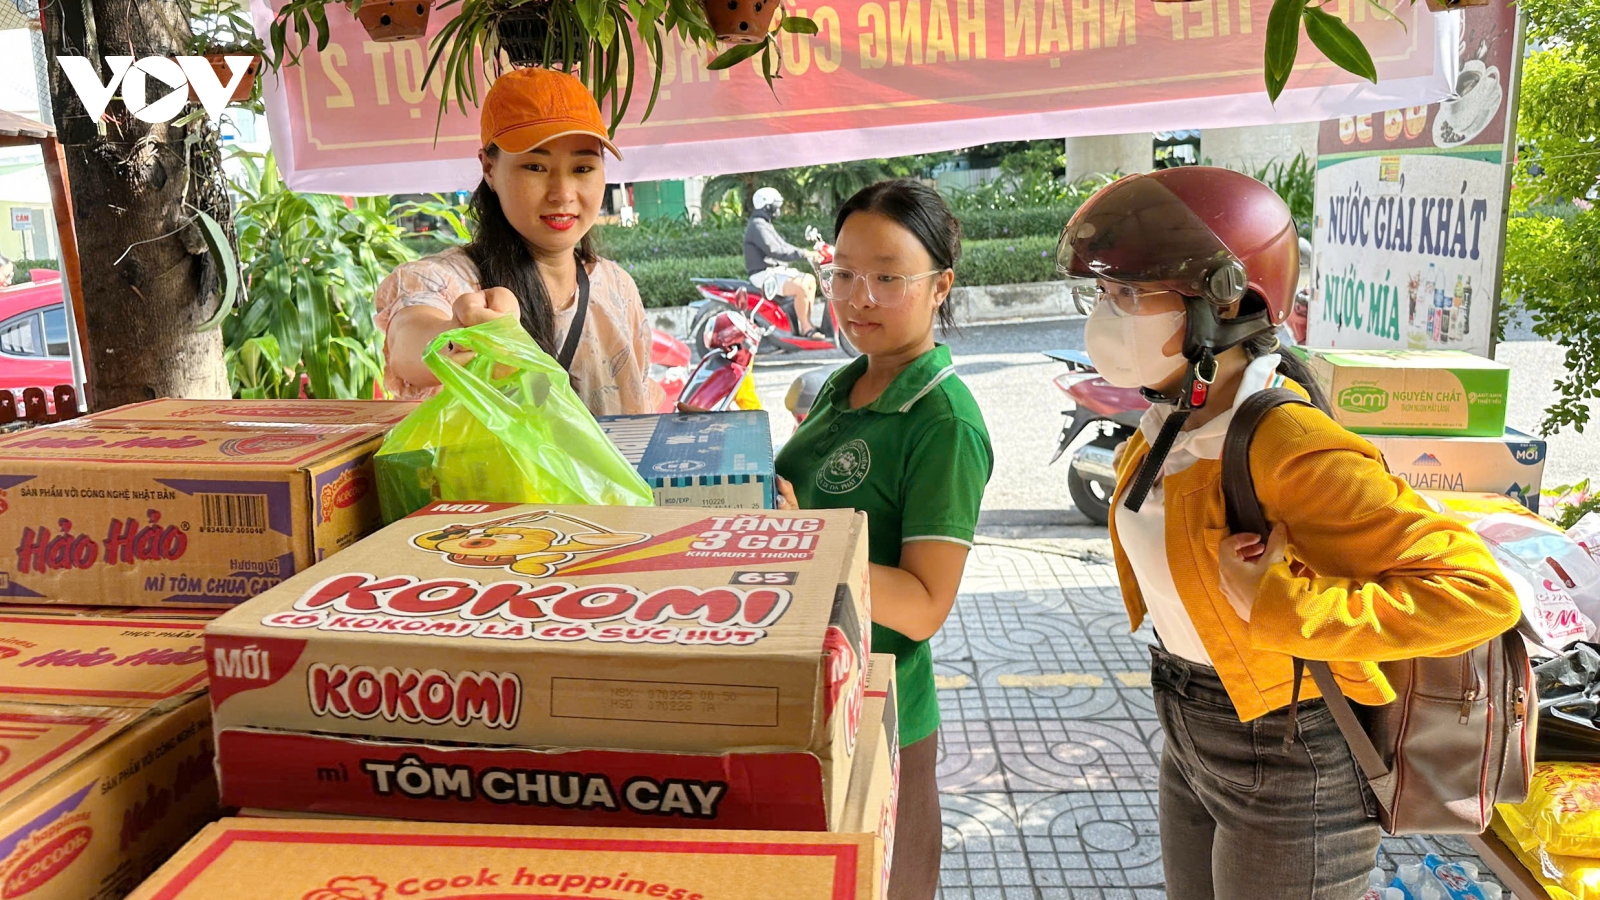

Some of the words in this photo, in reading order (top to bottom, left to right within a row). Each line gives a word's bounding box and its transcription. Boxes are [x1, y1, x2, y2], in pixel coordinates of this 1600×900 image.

[1328, 181, 1370, 247] NƯỚC
[1374, 173, 1416, 252] GIẢI
[1418, 180, 1487, 260] KHÁT
[1323, 264, 1365, 331] NƯỚC
[1367, 269, 1400, 340] MÍA
[1392, 390, 1434, 401] NGUYÊN
[1436, 389, 1462, 402] CHẤT
[20, 485, 38, 497] SẢN
[39, 484, 63, 498] PHẨM
[64, 486, 79, 498] VỚI
[80, 486, 105, 499] CÔNG
[106, 487, 131, 501] NGHỆ
[132, 488, 155, 501] NHẬT
[157, 487, 176, 500] BẢN
[1391, 472, 1465, 493] QUAFINA
[710, 514, 822, 534] TẶNG
[15, 517, 99, 574] Hảo
[102, 508, 188, 566] Hảo
[691, 530, 724, 551] 3
[686, 550, 710, 559] KHI
[711, 551, 746, 559] MUA
[760, 550, 808, 560] THÙNG
[230, 559, 265, 573] Hương
[268, 559, 279, 572] vị
[144, 573, 166, 592] MÌ
[169, 573, 202, 593] TÔM
[206, 577, 246, 595] CHUA
[738, 573, 789, 584] 65
[302, 574, 787, 625] KOKOMI
[155, 630, 195, 639] PHẨM
[271, 611, 319, 626] CÓ
[327, 616, 472, 634] KOKOMI
[481, 623, 525, 636] LÀ
[541, 624, 588, 638] CÓ
[597, 625, 672, 640] SỨC
[684, 626, 758, 642] HÚT
[214, 643, 271, 681] MỚI
[311, 665, 519, 726] KOKOMI
[101, 775, 118, 795] SẢN
[317, 762, 349, 783] mì
[365, 757, 471, 798] TÔM
[482, 770, 615, 809] CHUA
[625, 780, 723, 815] CAY
[395, 867, 502, 898] Cook
[511, 866, 704, 900] happiness
